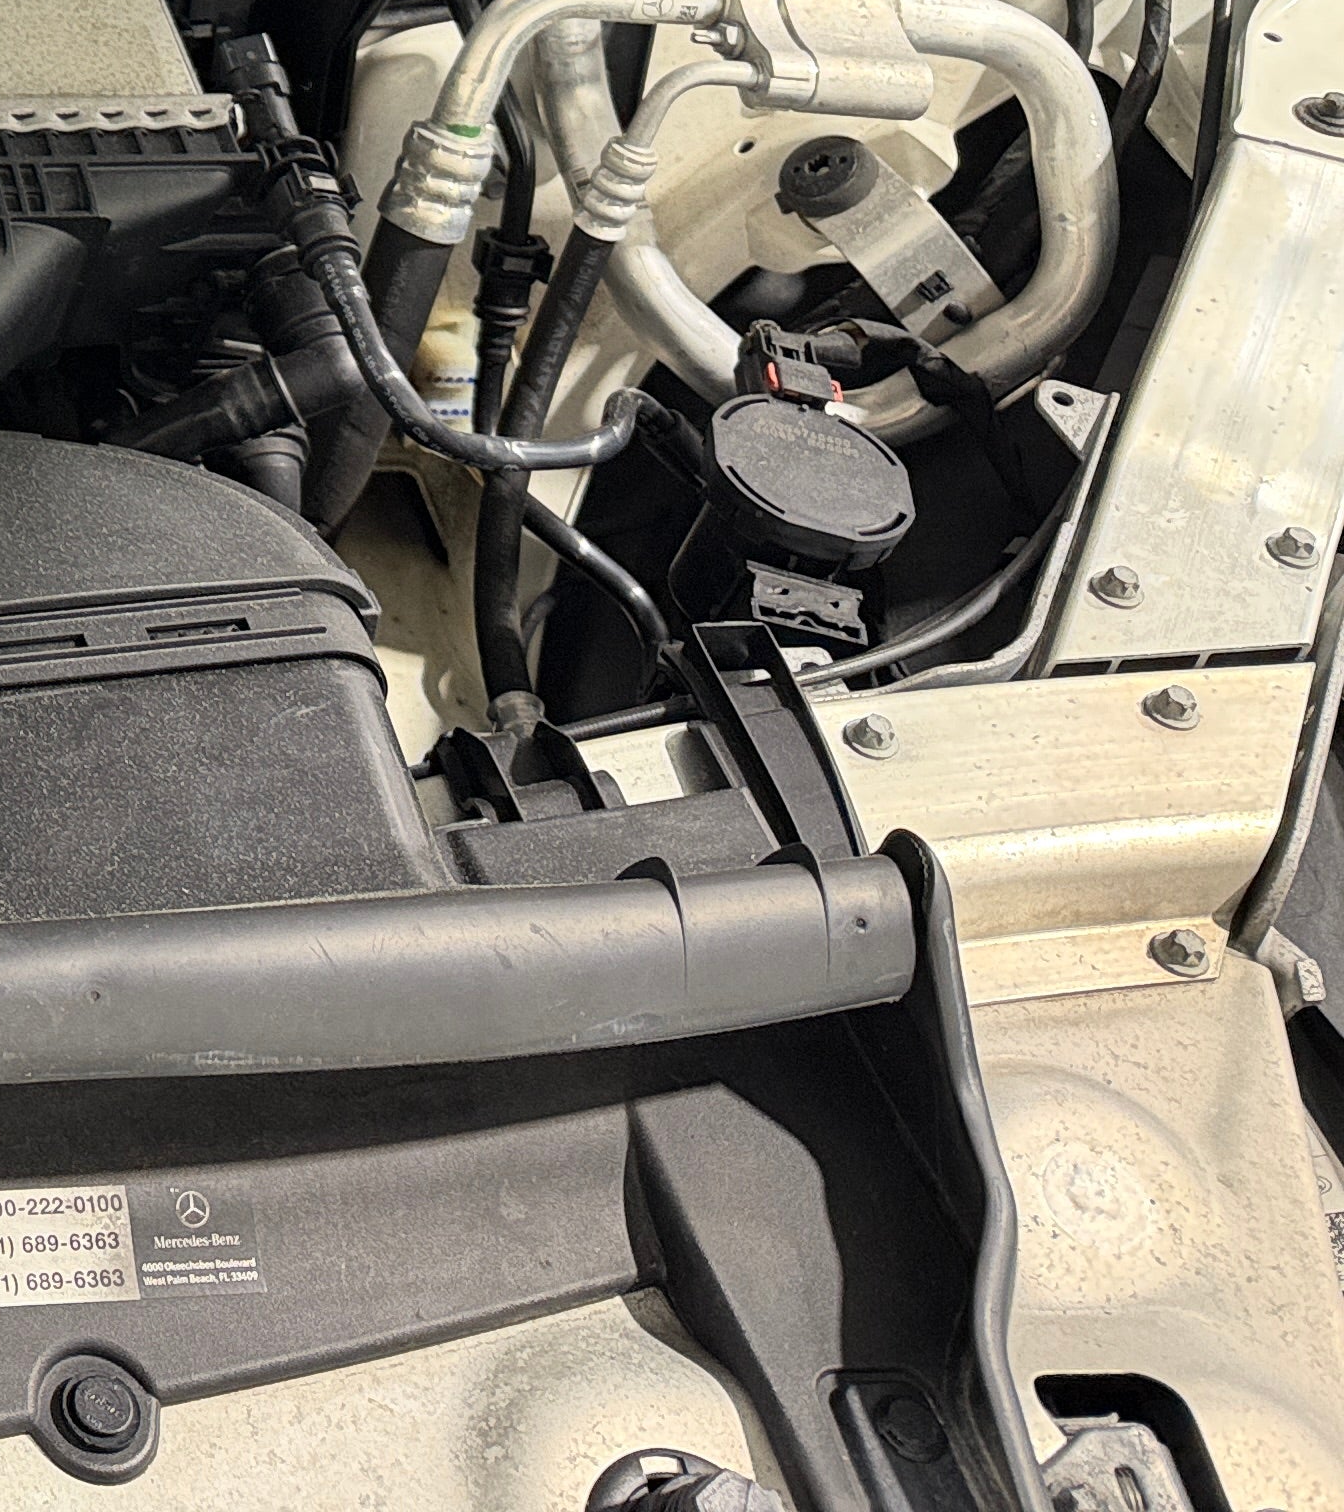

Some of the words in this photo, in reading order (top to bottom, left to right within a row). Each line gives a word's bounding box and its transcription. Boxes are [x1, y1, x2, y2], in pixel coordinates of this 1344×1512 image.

[22, 1231, 120, 1253] 689-6363
[153, 1233, 241, 1249] Mercedes-Benz
[141, 1261, 164, 1272] 4000
[215, 1257, 257, 1269] Boulevard
[26, 1269, 125, 1291] 689-6363
[143, 1275, 167, 1286] West
[167, 1274, 189, 1285] Palm
[219, 1271, 231, 1282] FL
[231, 1270, 259, 1281] 33409
